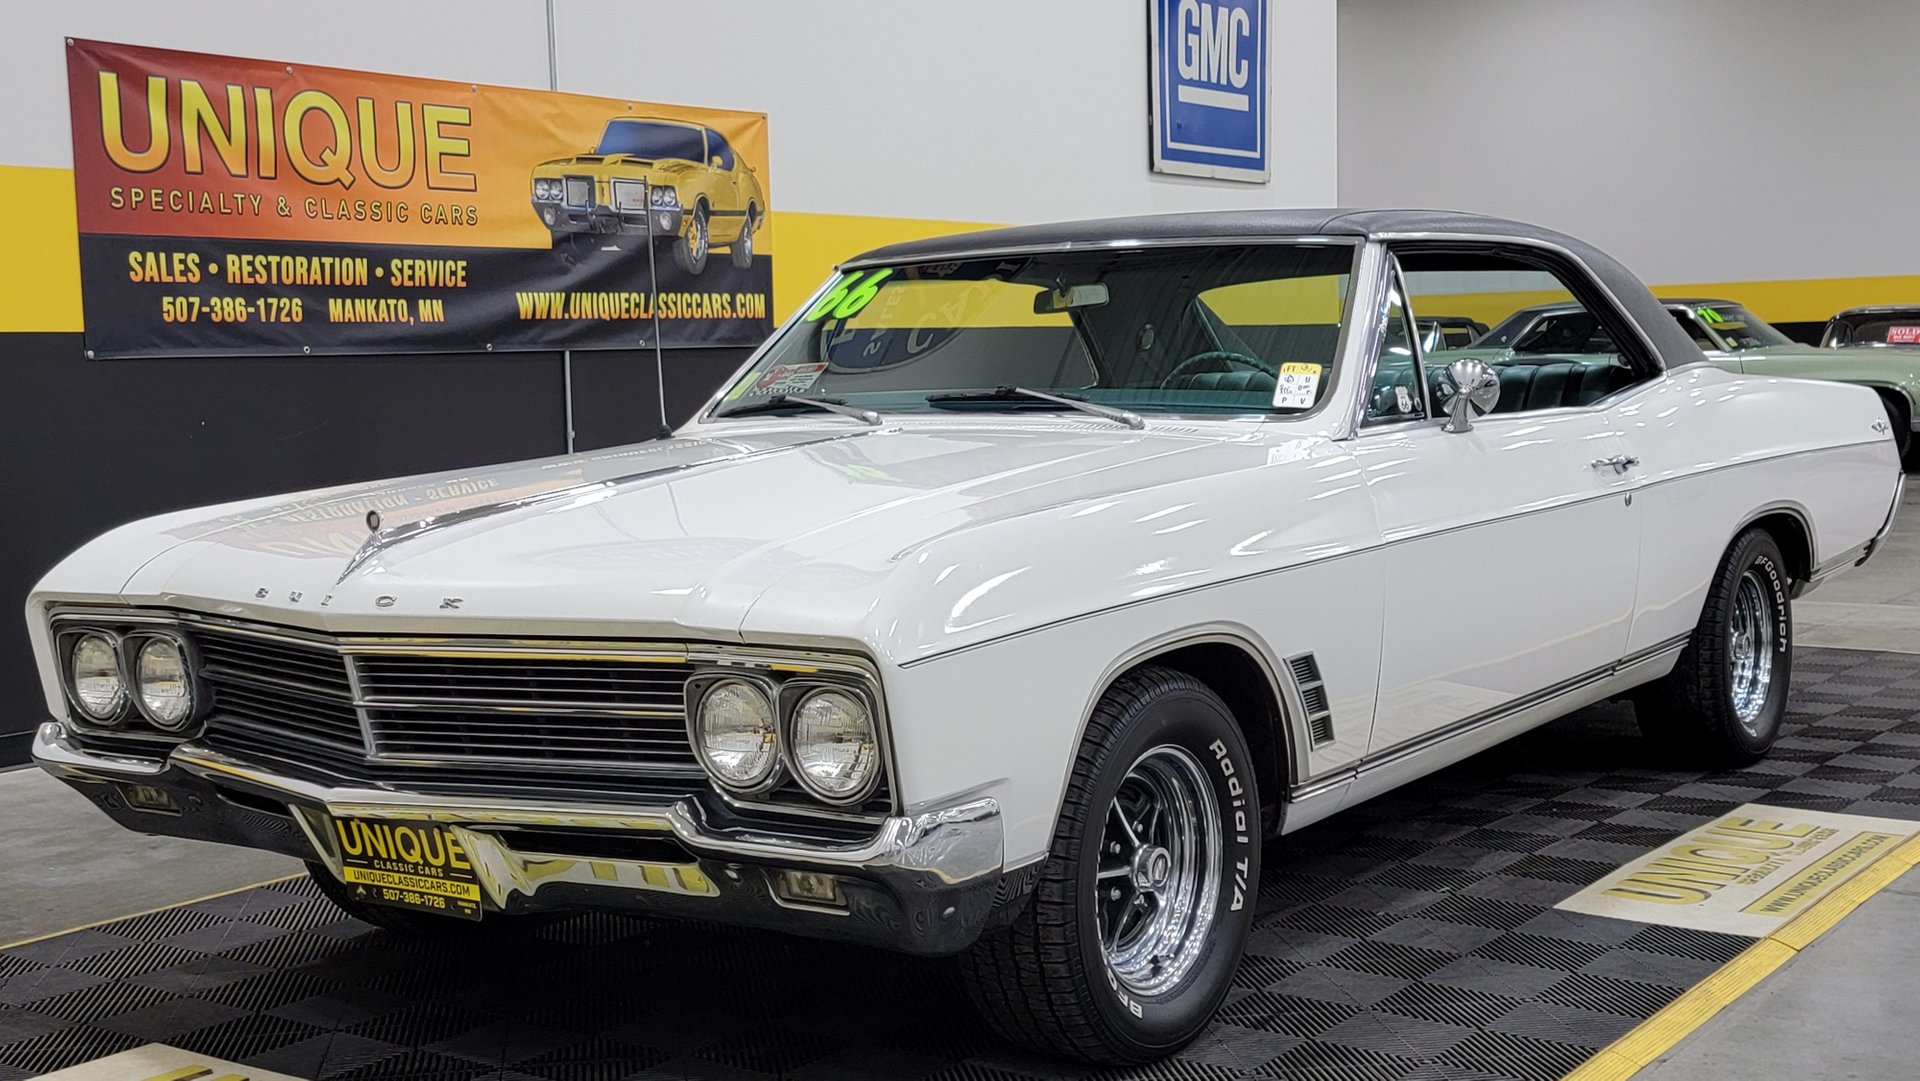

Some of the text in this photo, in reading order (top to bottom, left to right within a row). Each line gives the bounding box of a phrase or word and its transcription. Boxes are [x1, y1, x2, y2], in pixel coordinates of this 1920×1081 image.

[1177, 0, 1250, 89] GMC
[98, 70, 478, 192] UNIQUE
[110, 186, 479, 226] SPECIALTY & CLASSIC CARS
[129, 251, 467, 288] SALES RESTORATION SERVICE
[162, 296, 445, 326] 507-386-1726 MANKATO, MN
[806, 267, 894, 322] 66
[255, 587, 464, 609] BUICK
[1754, 555, 1788, 653] BFGoodrich
[336, 819, 472, 870] UNIQUE
[1208, 739, 1249, 913] Radial T/A
[353, 869, 471, 897] UNIQUECLASSICCARS.COM
[373, 859, 444, 878] CLASSIC CARS
[1601, 816, 1821, 906] UNIQUE
[382, 888, 446, 909] 507-386-1726
